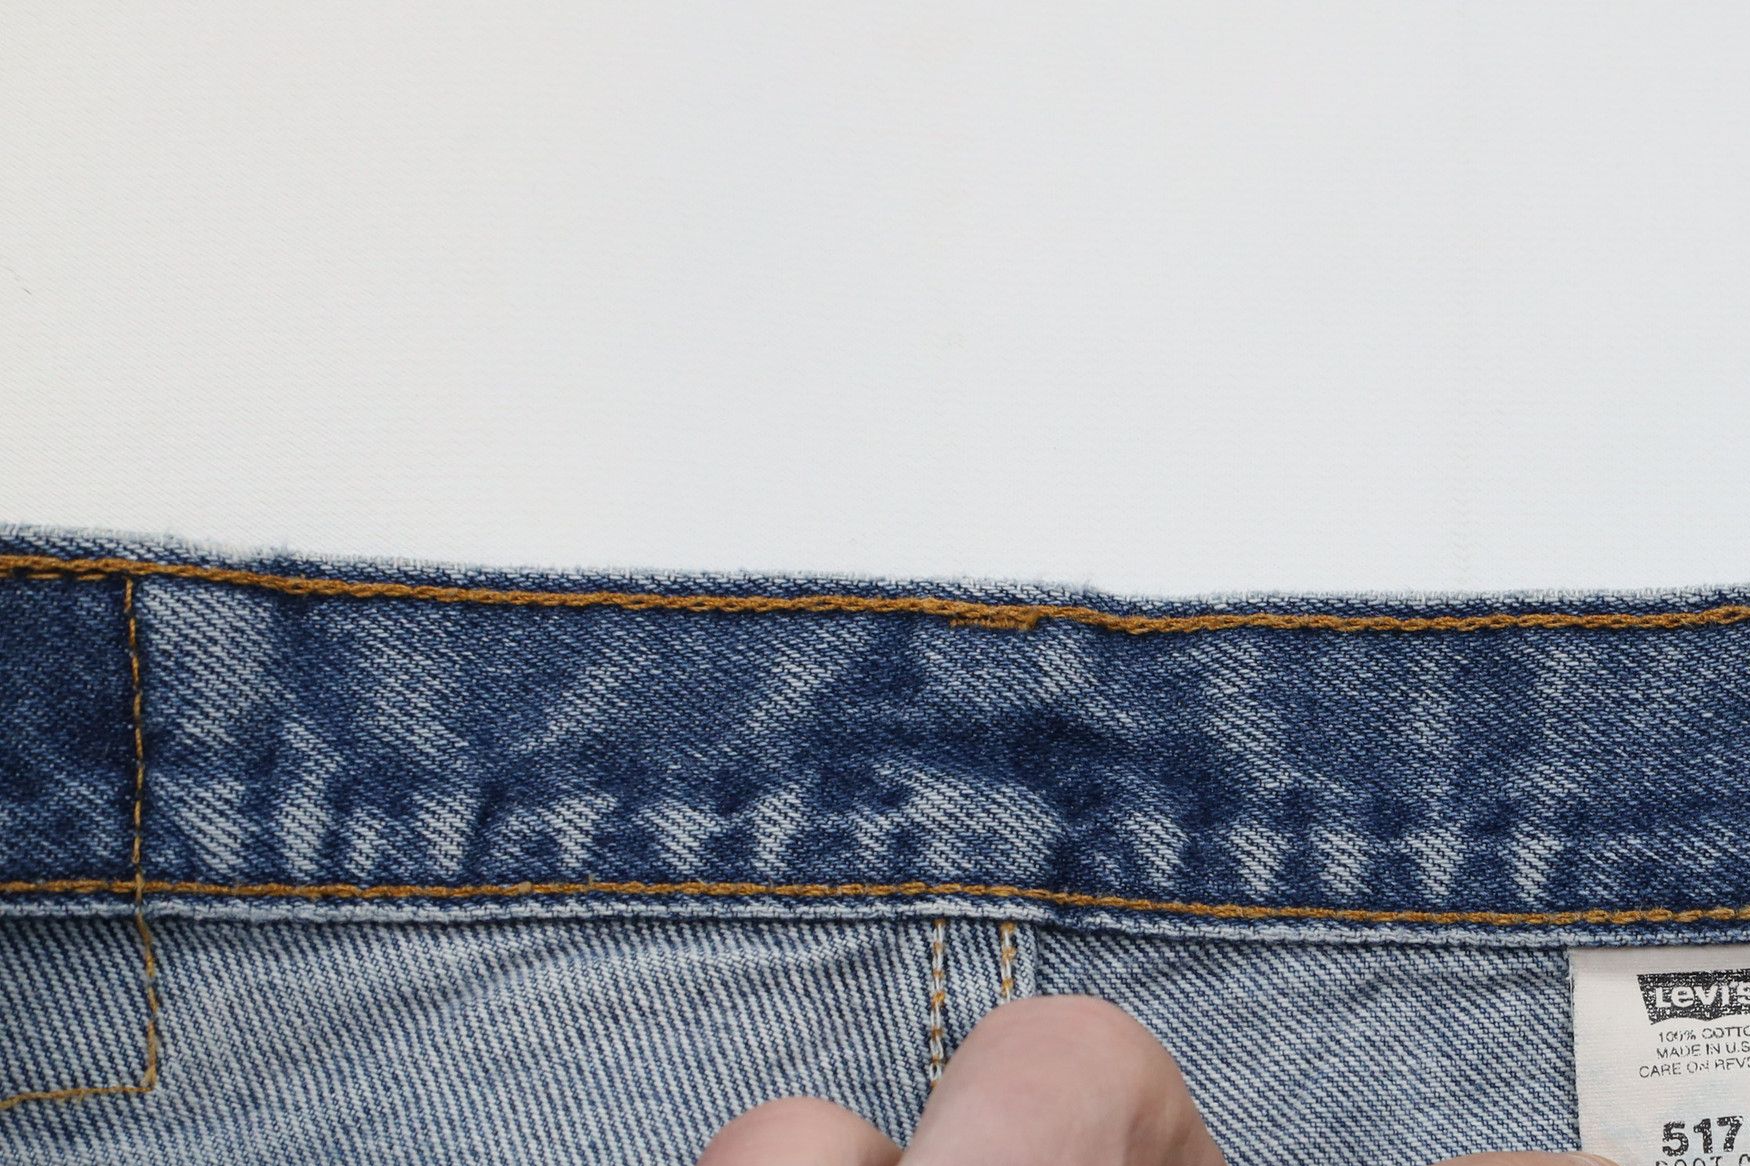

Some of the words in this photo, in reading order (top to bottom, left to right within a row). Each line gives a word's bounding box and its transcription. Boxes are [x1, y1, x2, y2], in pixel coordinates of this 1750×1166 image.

[1659, 1029, 1697, 1043] 100%
[1656, 1044, 1701, 1059] MADE
[1705, 1043, 1721, 1055] IN
[1639, 1062, 1681, 1078] CARE
[1687, 1060, 1709, 1074] ON
